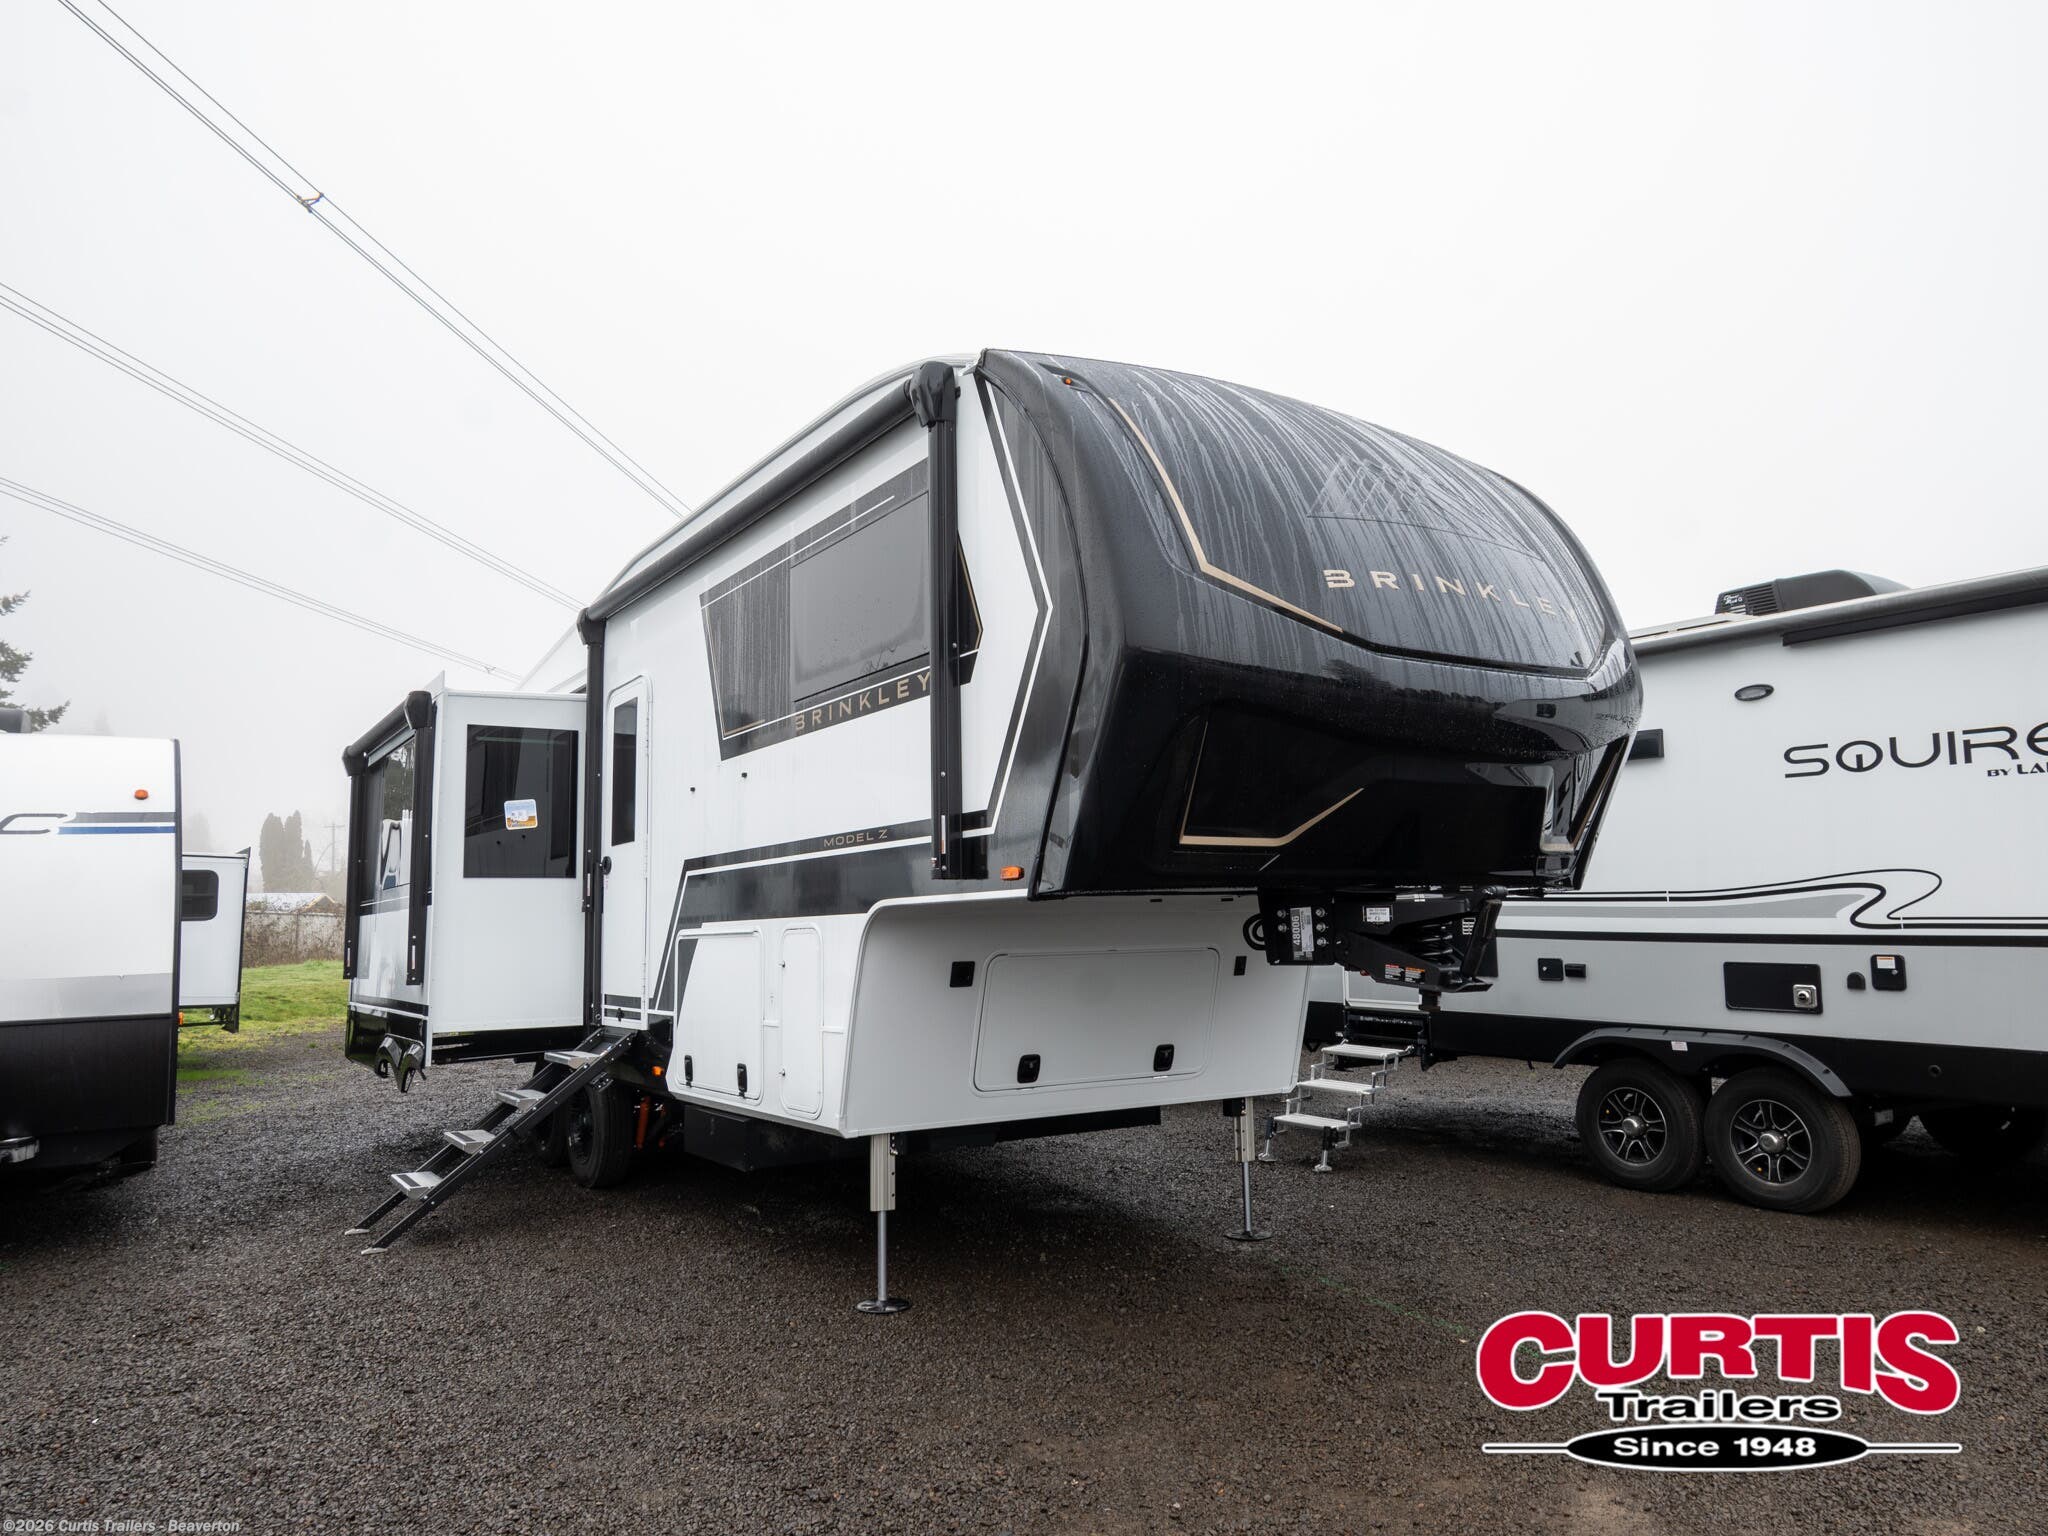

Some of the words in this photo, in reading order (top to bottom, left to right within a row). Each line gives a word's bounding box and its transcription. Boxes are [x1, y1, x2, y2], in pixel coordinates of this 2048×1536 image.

[1323, 569, 1577, 623] BRINKLEY
[794, 671, 931, 737] BRINKLEY
[1987, 768, 2011, 777] BY
[2016, 762, 2048, 775] LA
[823, 832, 875, 847] MODEL
[878, 828, 888, 839] Z
